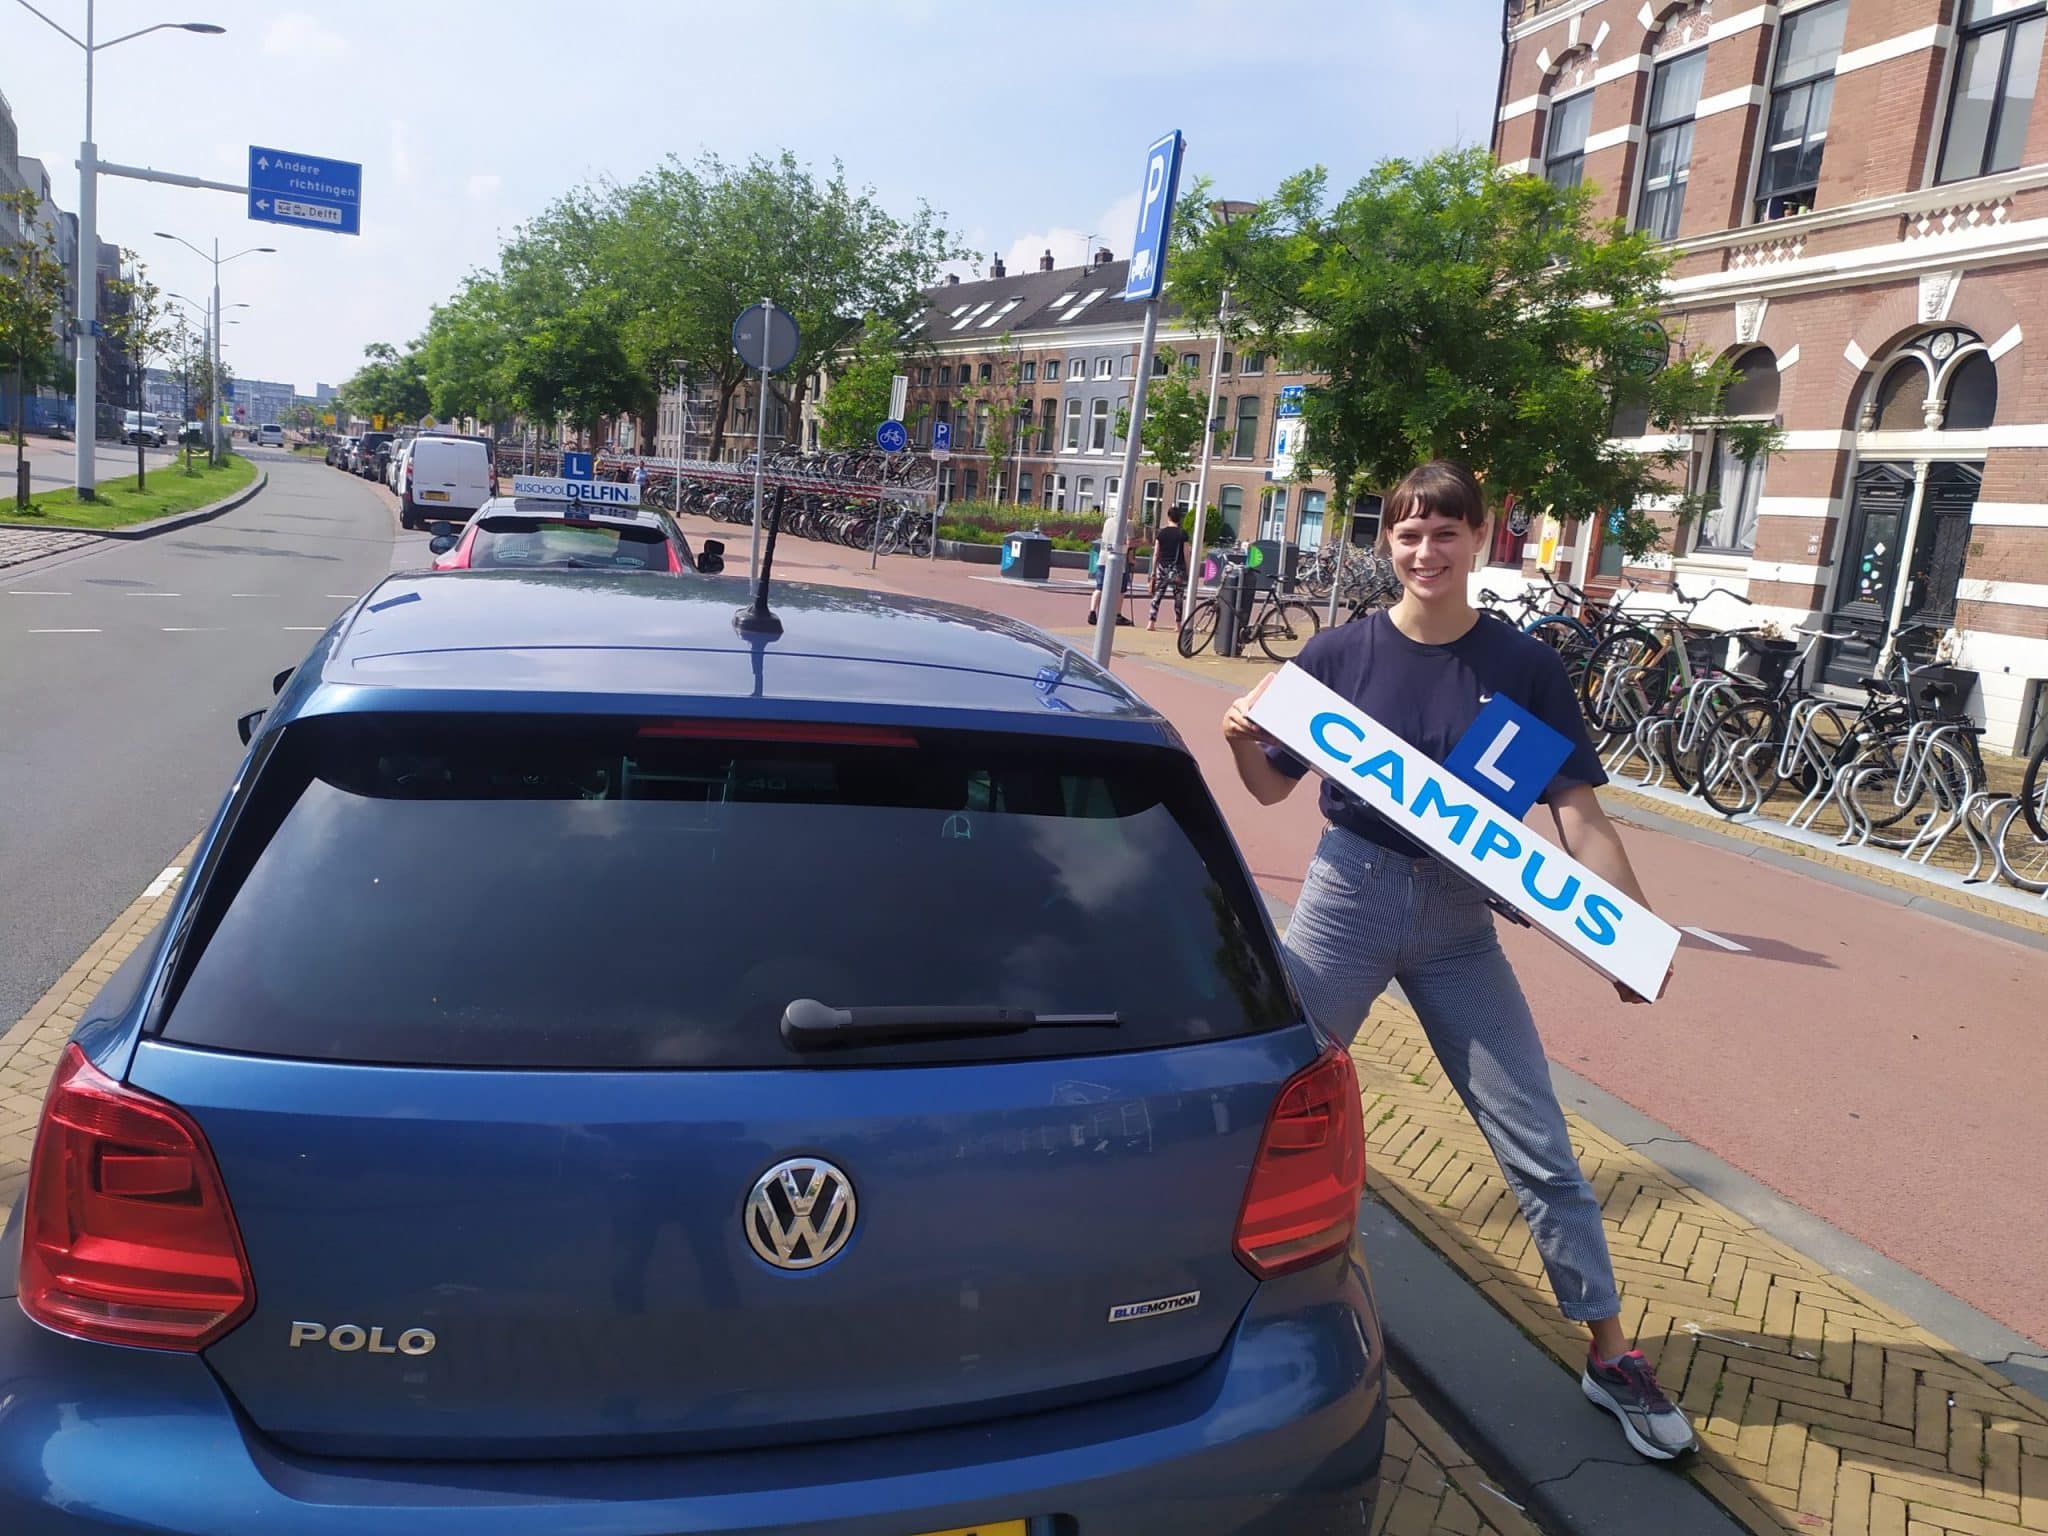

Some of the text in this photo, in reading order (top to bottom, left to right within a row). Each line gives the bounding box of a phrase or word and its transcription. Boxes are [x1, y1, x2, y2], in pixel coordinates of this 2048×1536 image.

[275, 159, 321, 175] Andere
[289, 178, 356, 198] richtingen
[1140, 154, 1165, 233] P
[309, 207, 338, 220] Delft
[937, 424, 948, 439] P
[572, 457, 584, 475] L
[566, 484, 629, 502] DELFIN
[1473, 719, 1521, 793] L
[1309, 711, 1624, 946] CAMPUS
[1113, 1294, 1197, 1319] BLUEMOTION
[289, 1320, 437, 1356] POLO
